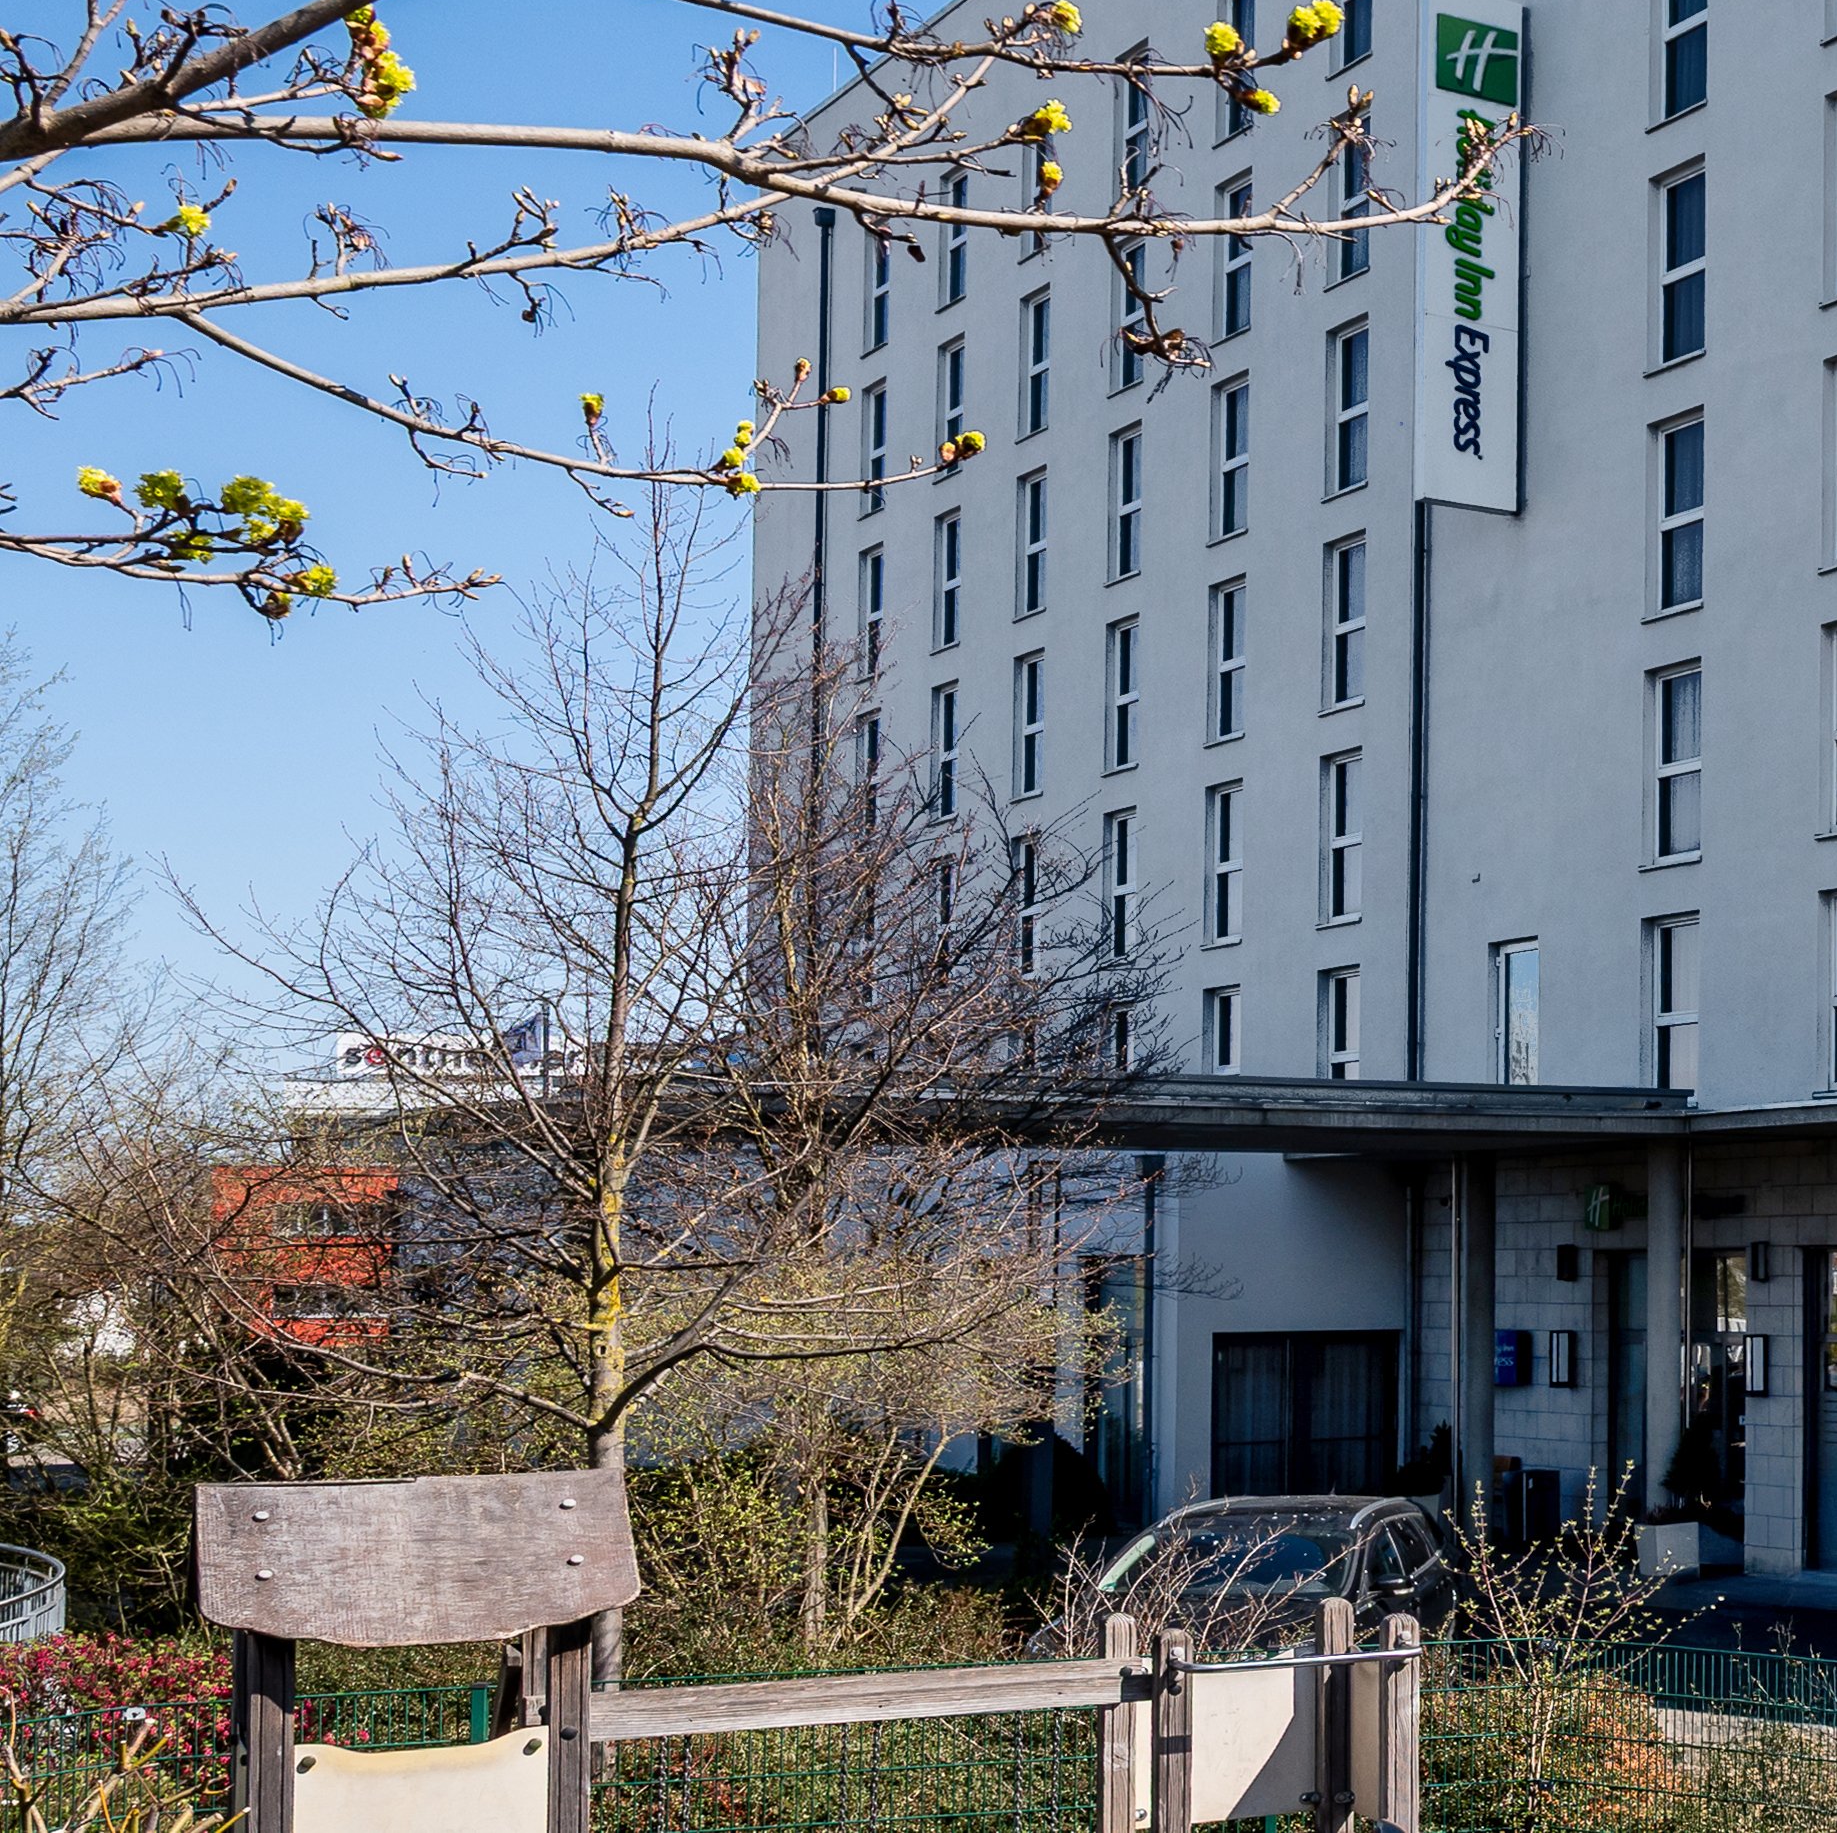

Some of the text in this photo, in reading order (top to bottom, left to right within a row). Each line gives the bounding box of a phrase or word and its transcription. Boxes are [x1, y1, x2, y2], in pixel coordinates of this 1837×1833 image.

[1445, 108, 1498, 458] Hday Inn Express
[1612, 1192, 1649, 1217] Holid
[1494, 1356, 1515, 1367] ress
